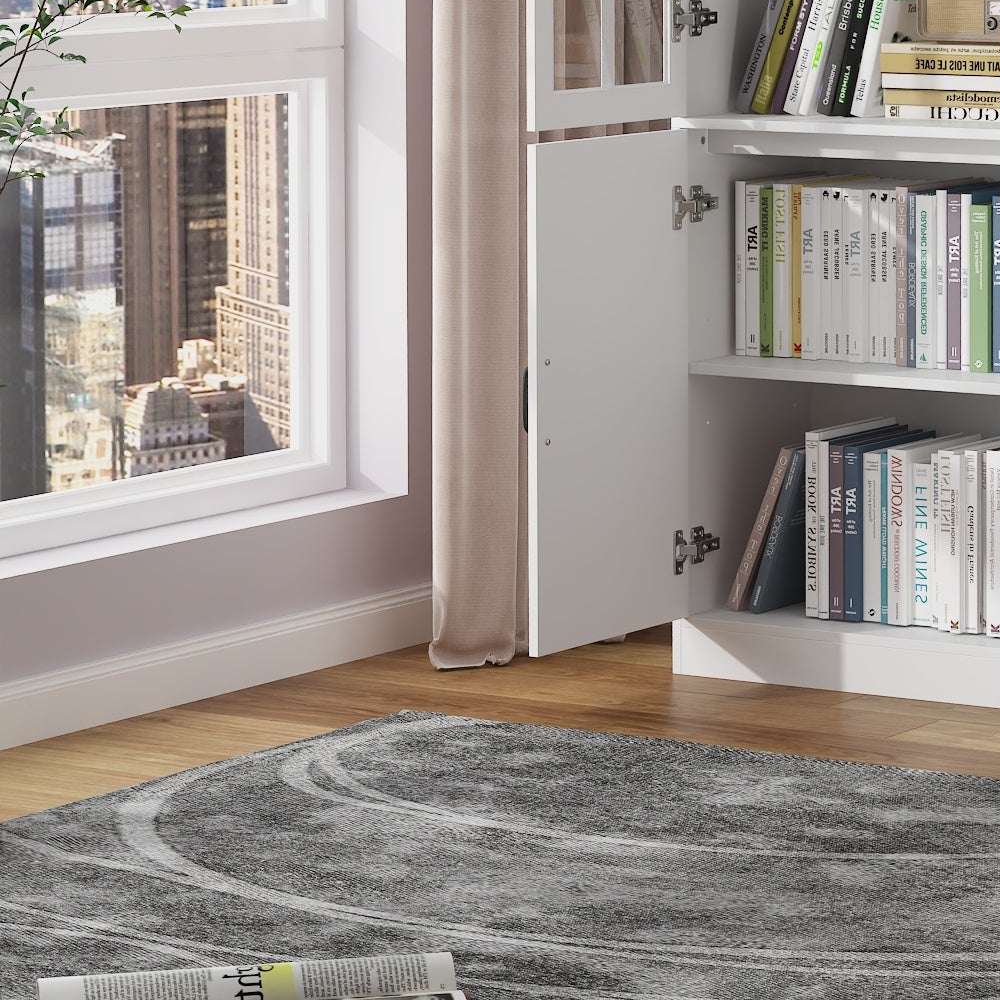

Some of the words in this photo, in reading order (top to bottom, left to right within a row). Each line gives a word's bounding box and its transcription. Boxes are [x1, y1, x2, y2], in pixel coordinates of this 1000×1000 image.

[790, 23, 802, 51] FORM
[742, 34, 766, 94] WASHINGTON
[789, 79, 801, 102] State
[795, 47, 810, 79] Capital
[822, 64, 837, 106] Queensland
[838, 64, 851, 103] FORMULA
[850, 31, 858, 50] FOR
[755, 75, 774, 105] Italia
